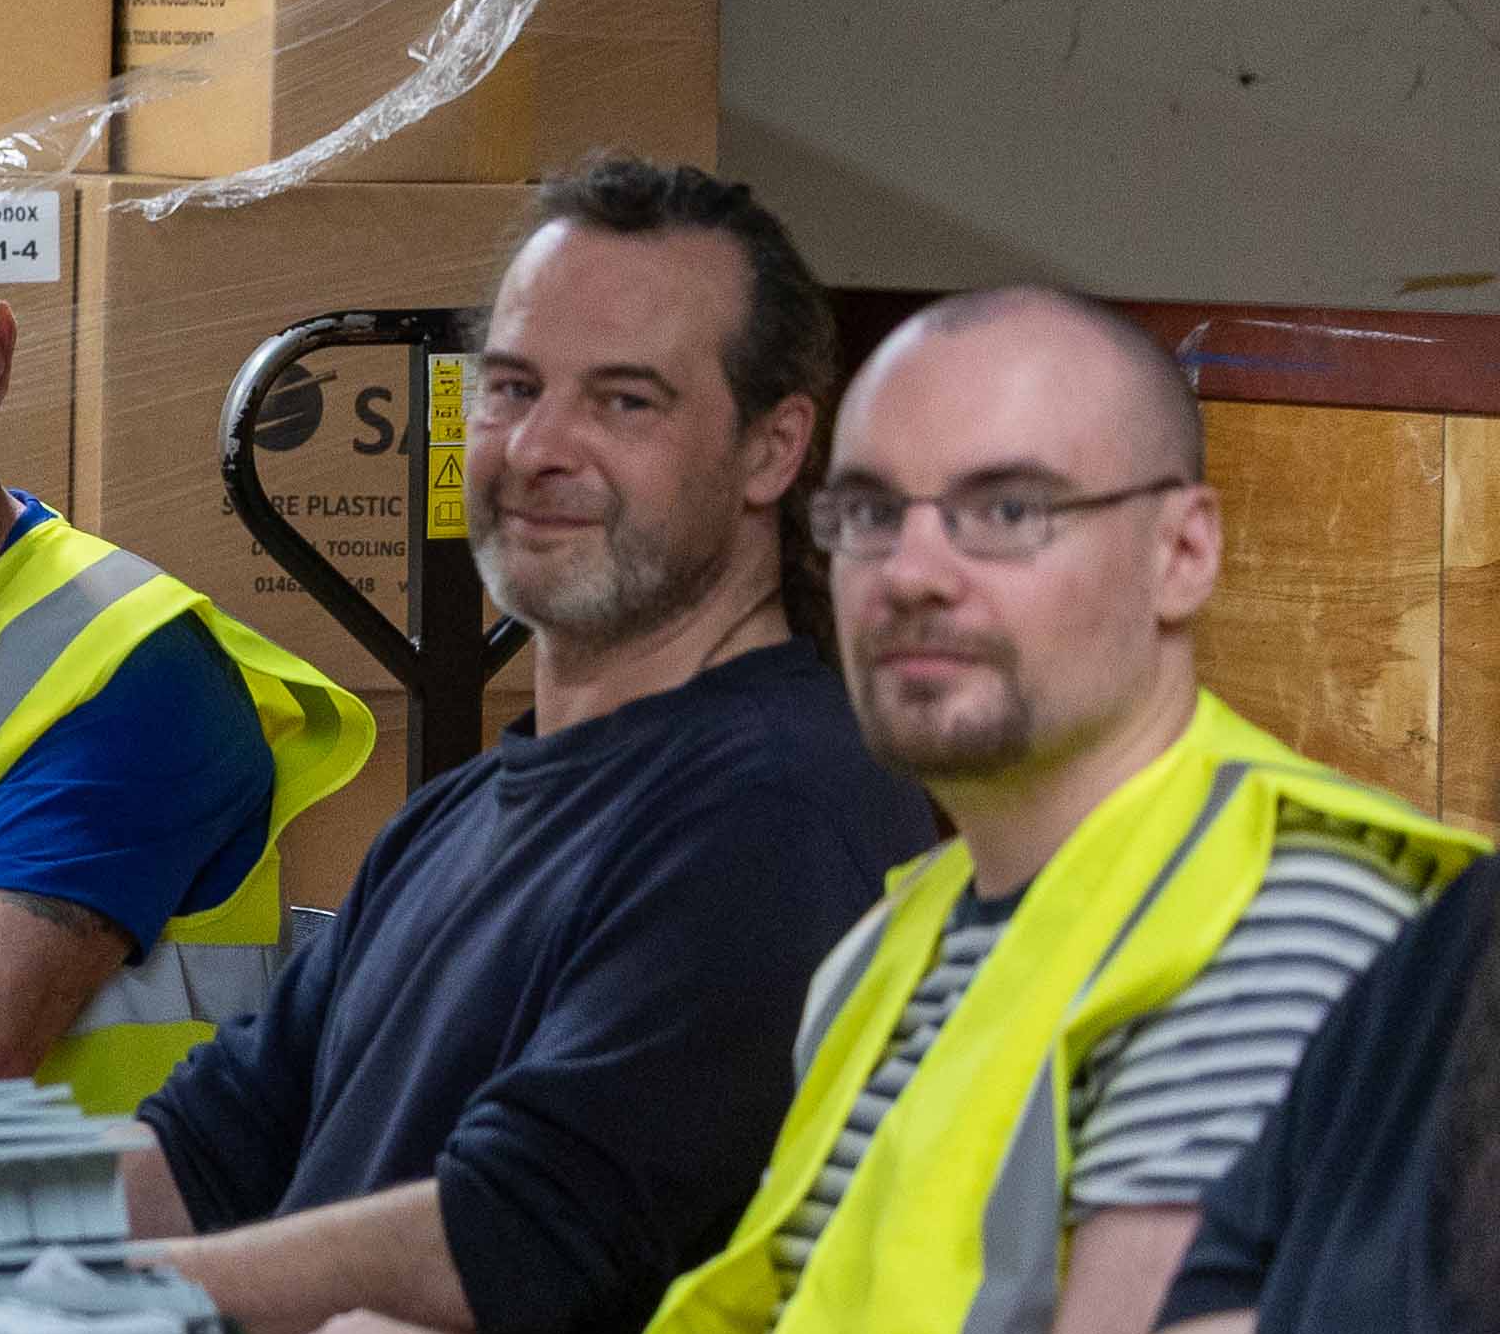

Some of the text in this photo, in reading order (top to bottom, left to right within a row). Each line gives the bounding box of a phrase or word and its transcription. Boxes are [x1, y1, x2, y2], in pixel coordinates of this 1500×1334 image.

[221, 495, 403, 517] SRE PLASTIC
[327, 540, 405, 557] TOOLING
